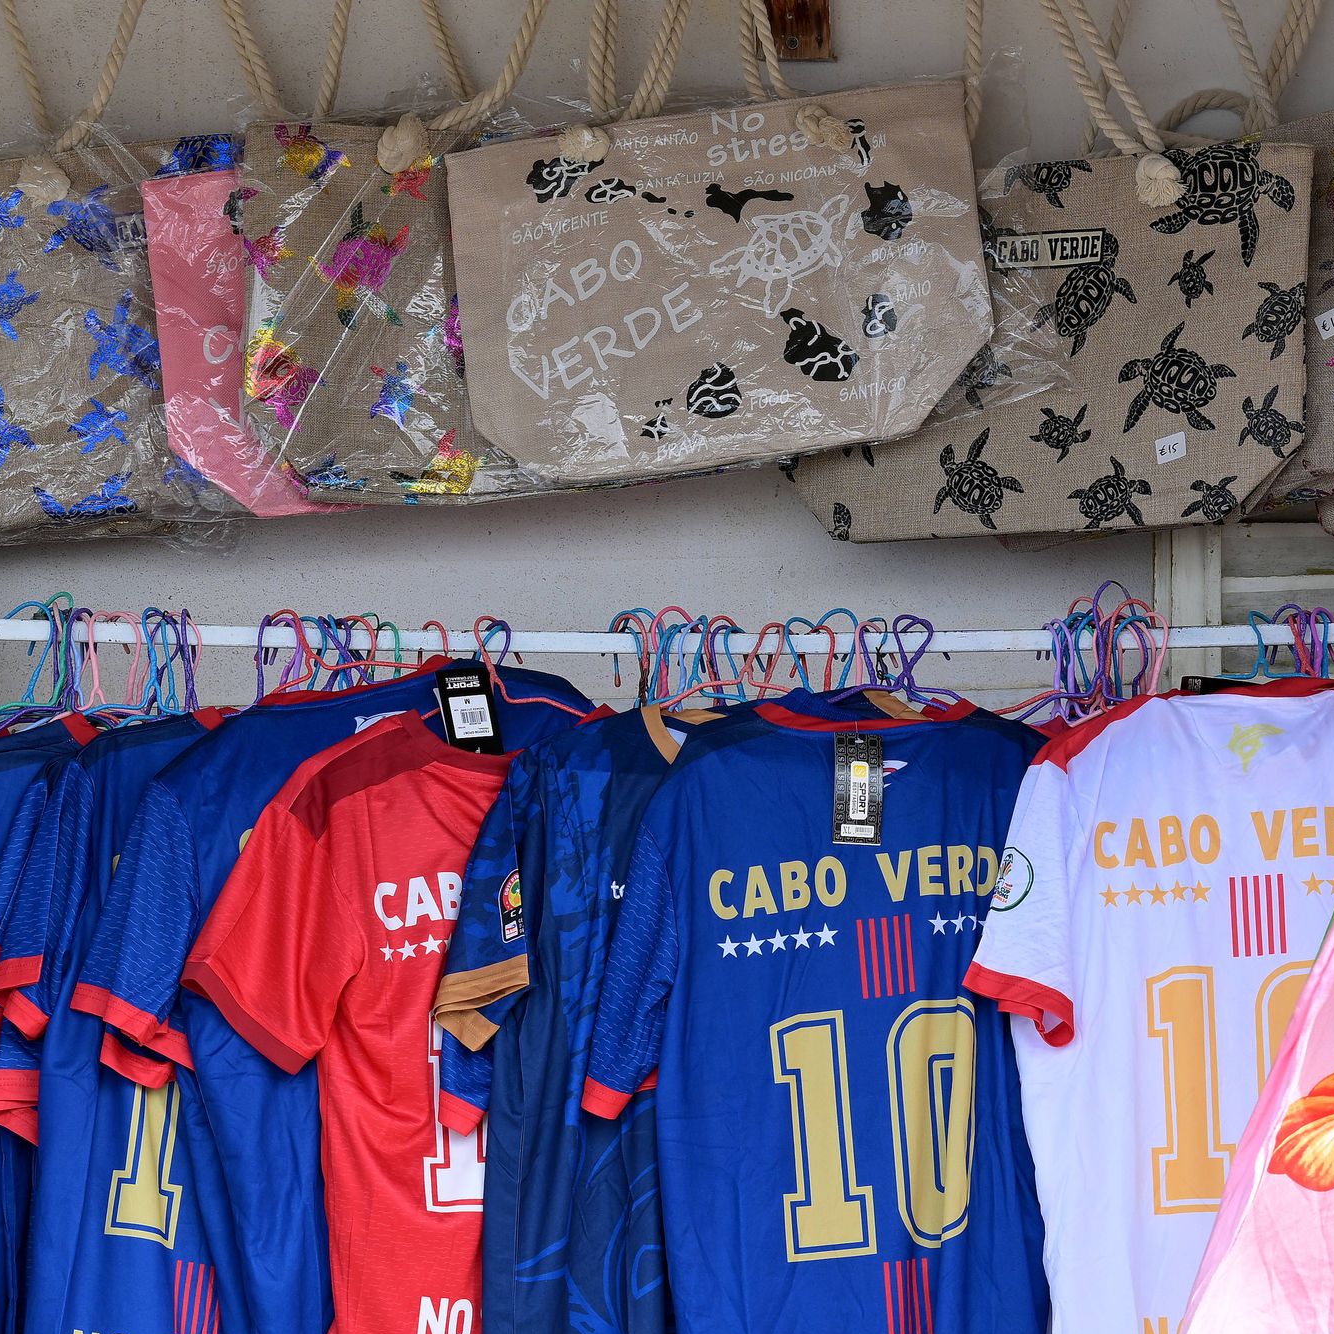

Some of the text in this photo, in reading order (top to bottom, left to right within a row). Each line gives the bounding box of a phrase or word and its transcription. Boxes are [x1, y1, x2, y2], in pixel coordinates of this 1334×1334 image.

[653, 128, 698, 147] ANTÃO
[711, 111, 764, 136] No
[706, 130, 812, 166] stres
[636, 171, 725, 191] SANTA LUZIA
[744, 170, 774, 187] SÃO
[511, 211, 609, 245] SÃO VICENTE
[871, 242, 927, 262] BOA VISTA
[997, 233, 1102, 264] CABO VERDE
[506, 240, 642, 332] CABO
[896, 280, 931, 302] MAIO
[509, 281, 703, 400] VERDE
[750, 389, 790, 410] FOGO
[839, 376, 906, 402] SANTIAGO
[656, 434, 708, 462] BRAVA
[1158, 440, 1180, 457] €15
[446, 681, 480, 689] SPORT
[858, 782, 868, 814] SPORT
[1093, 814, 1222, 870] CABO
[708, 843, 999, 920] CABO VERD
[373, 871, 462, 931] CAB
[770, 997, 979, 1264] 10
